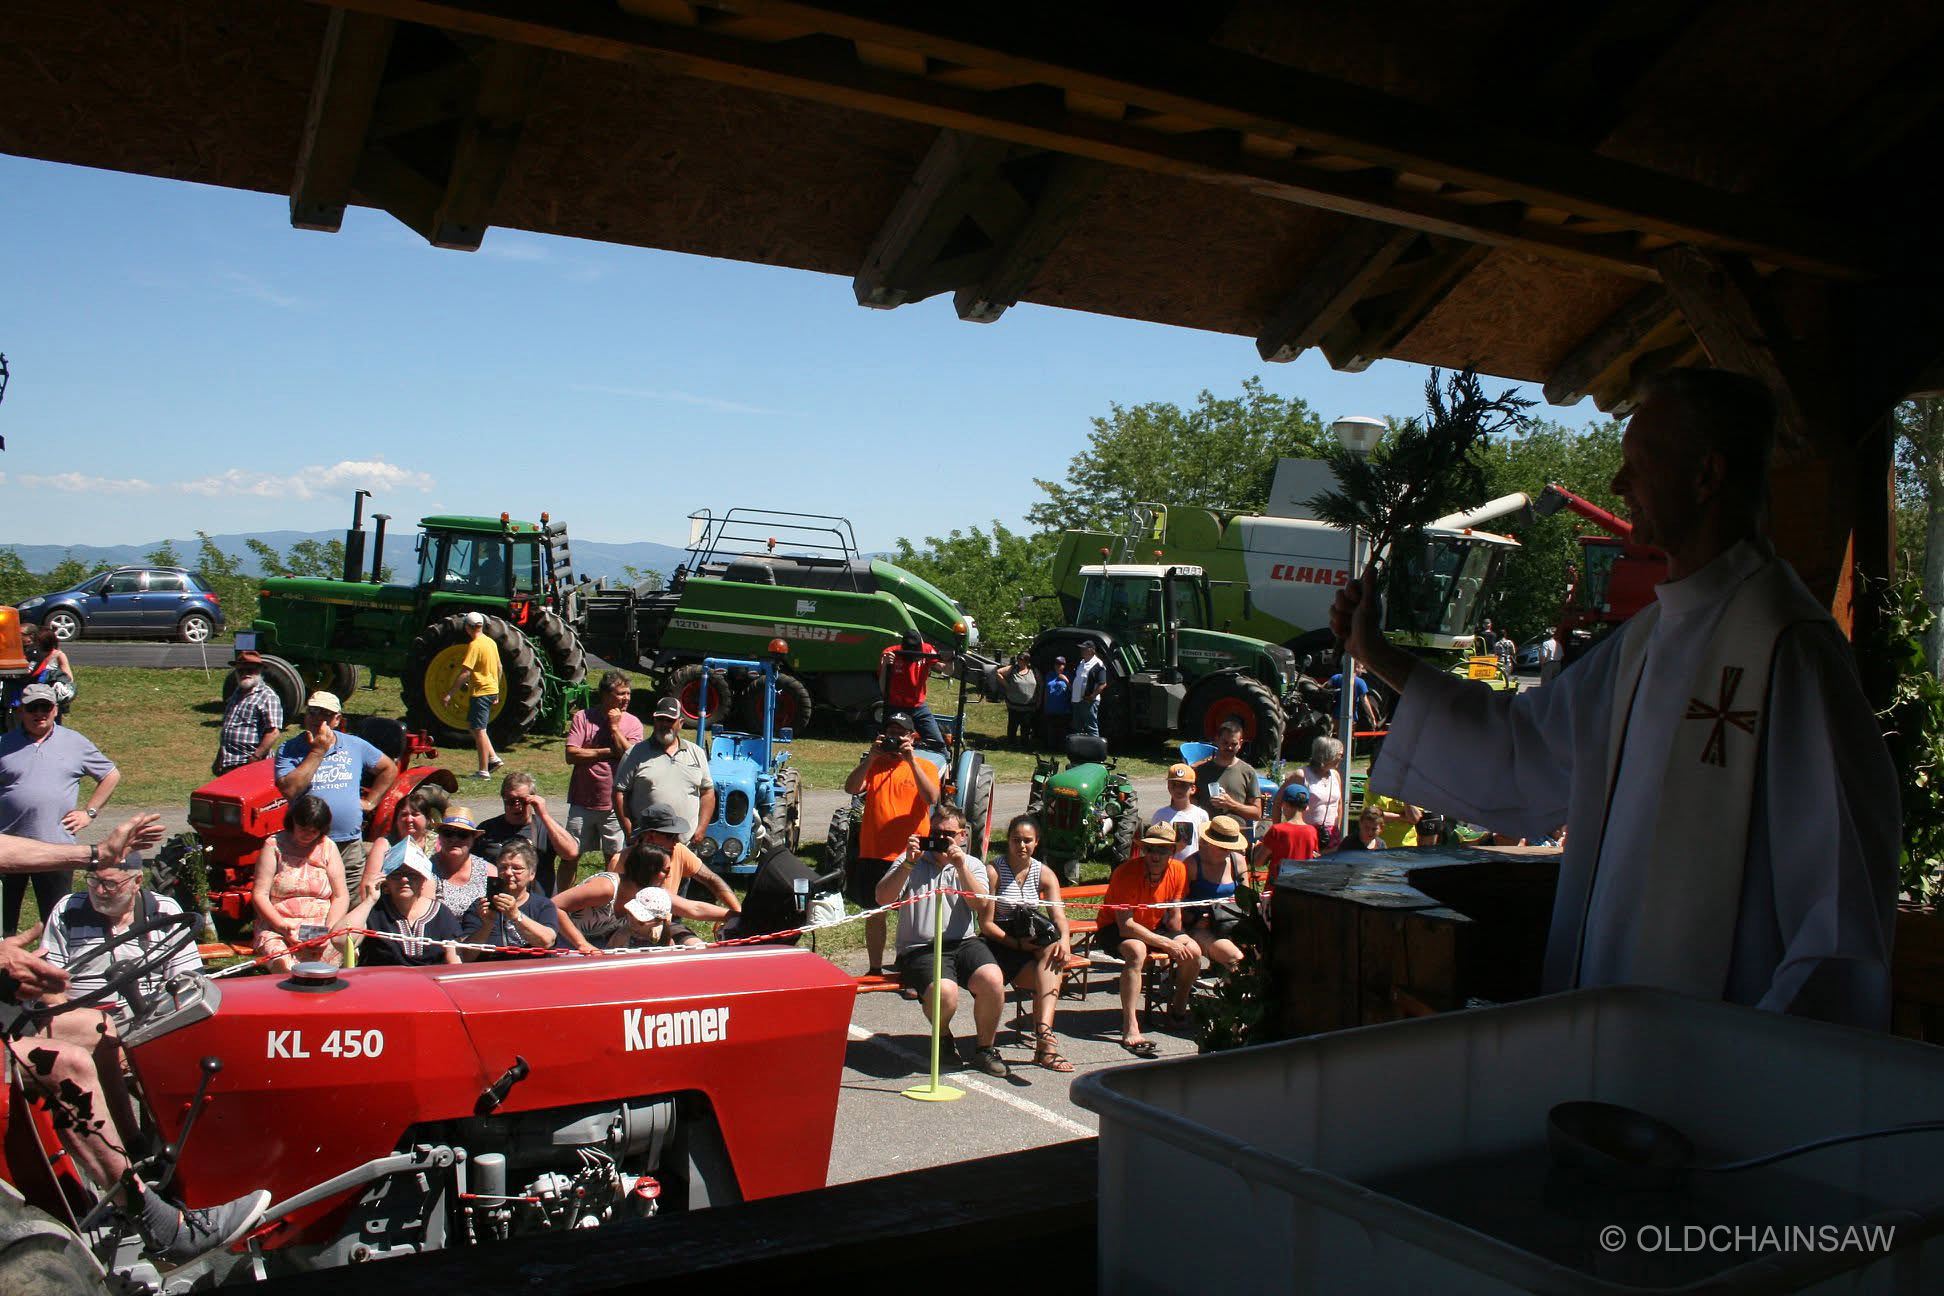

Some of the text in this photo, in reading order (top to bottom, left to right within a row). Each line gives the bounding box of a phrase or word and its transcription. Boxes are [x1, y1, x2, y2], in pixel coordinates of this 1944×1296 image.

[1271, 564, 1348, 586] CLAAS
[675, 619, 699, 629] 1270
[774, 623, 842, 641] FENDT
[623, 1007, 730, 1052] Kramer
[267, 1029, 384, 1058] KL 450
